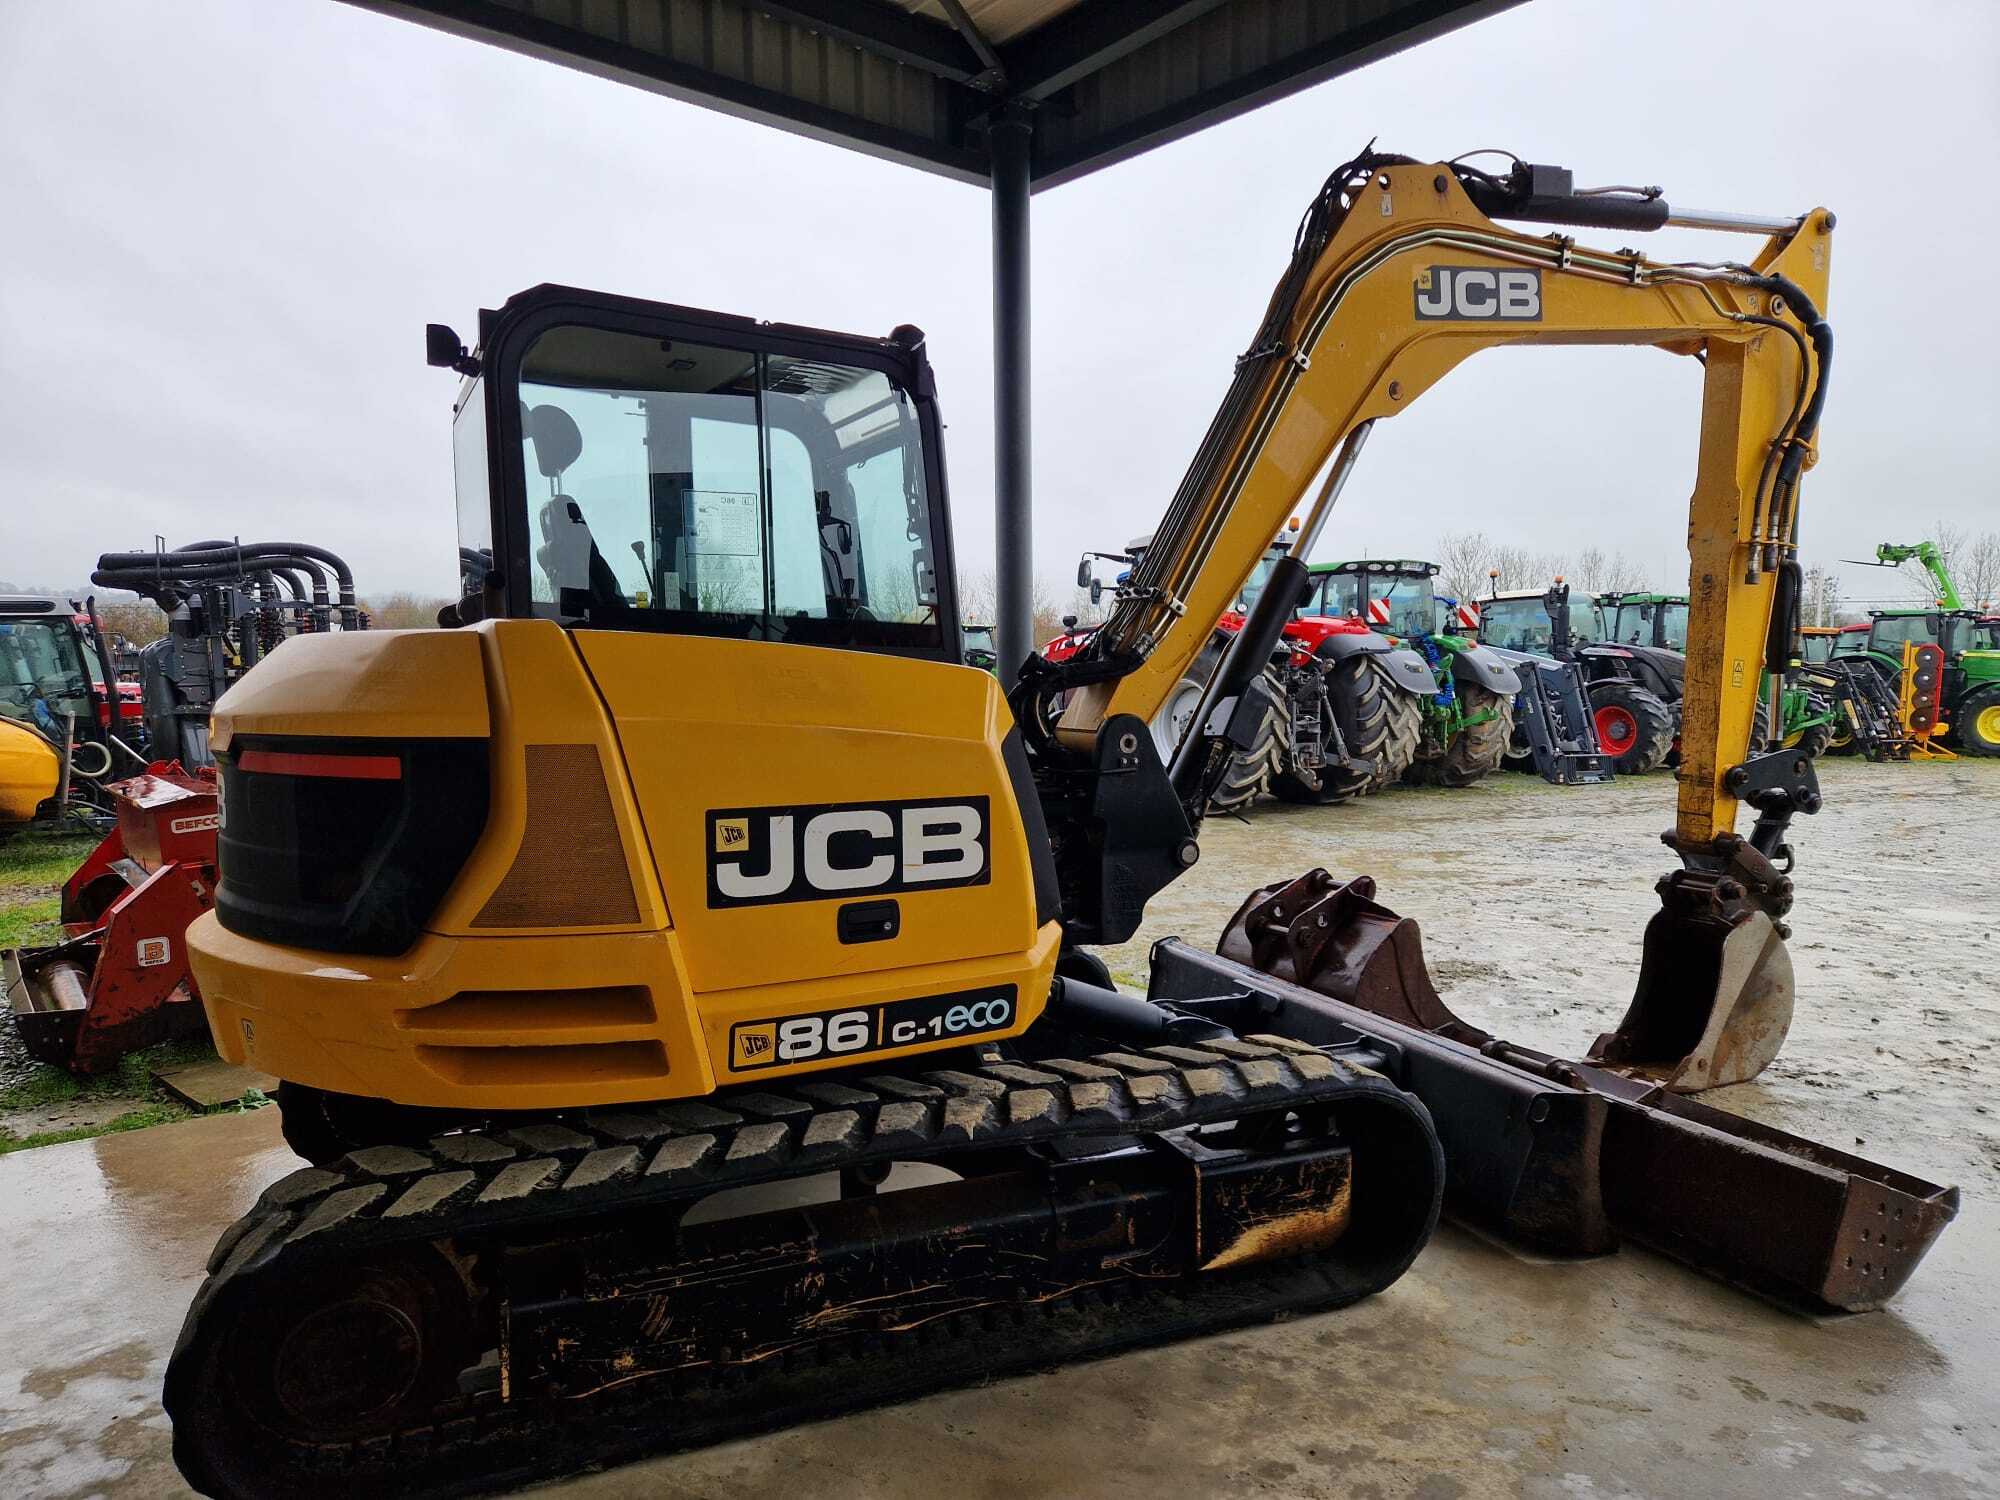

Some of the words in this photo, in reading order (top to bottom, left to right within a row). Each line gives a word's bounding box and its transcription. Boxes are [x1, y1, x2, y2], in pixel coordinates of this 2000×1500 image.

[1418, 270, 1540, 317] JCB
[716, 805, 984, 898] JCB
[724, 827, 745, 844] JCB
[744, 1036, 769, 1056] JCB
[778, 1011, 869, 1060] 86
[892, 1016, 943, 1042] C-1
[944, 998, 1010, 1032] eco
